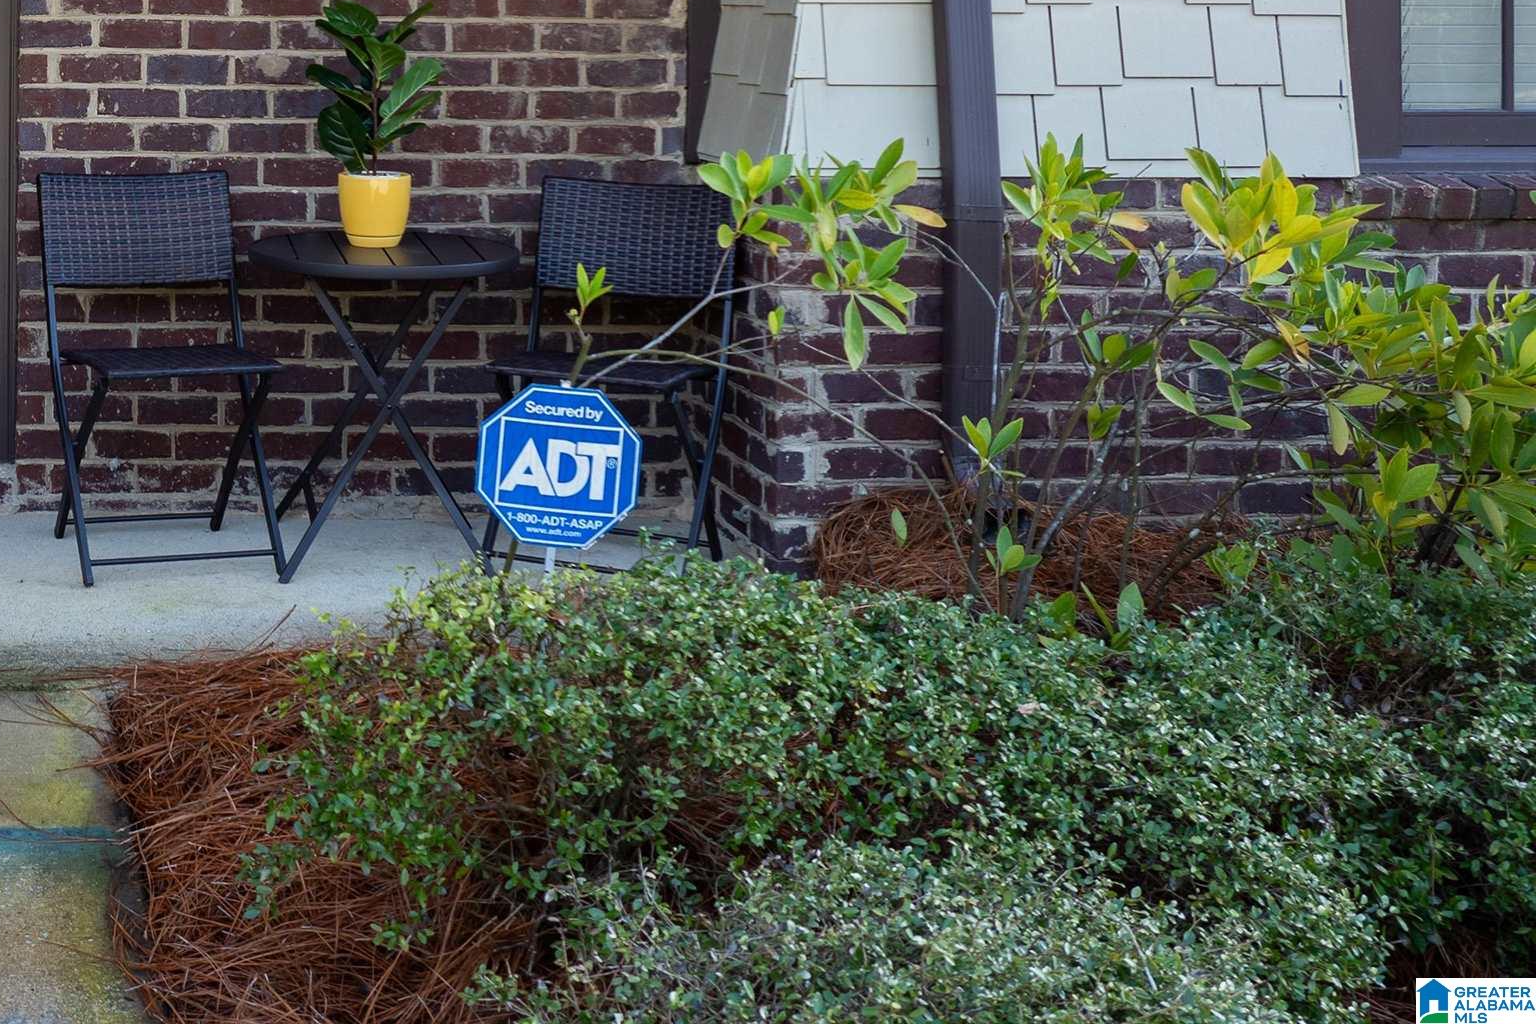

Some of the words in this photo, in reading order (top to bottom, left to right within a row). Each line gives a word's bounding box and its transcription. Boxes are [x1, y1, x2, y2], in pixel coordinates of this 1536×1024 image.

[525, 400, 585, 418] Secured
[586, 406, 603, 422] by
[499, 438, 620, 500] ADT
[507, 512, 603, 530] 1-800-ADT-ASAP
[526, 526, 582, 537] www.adt.com
